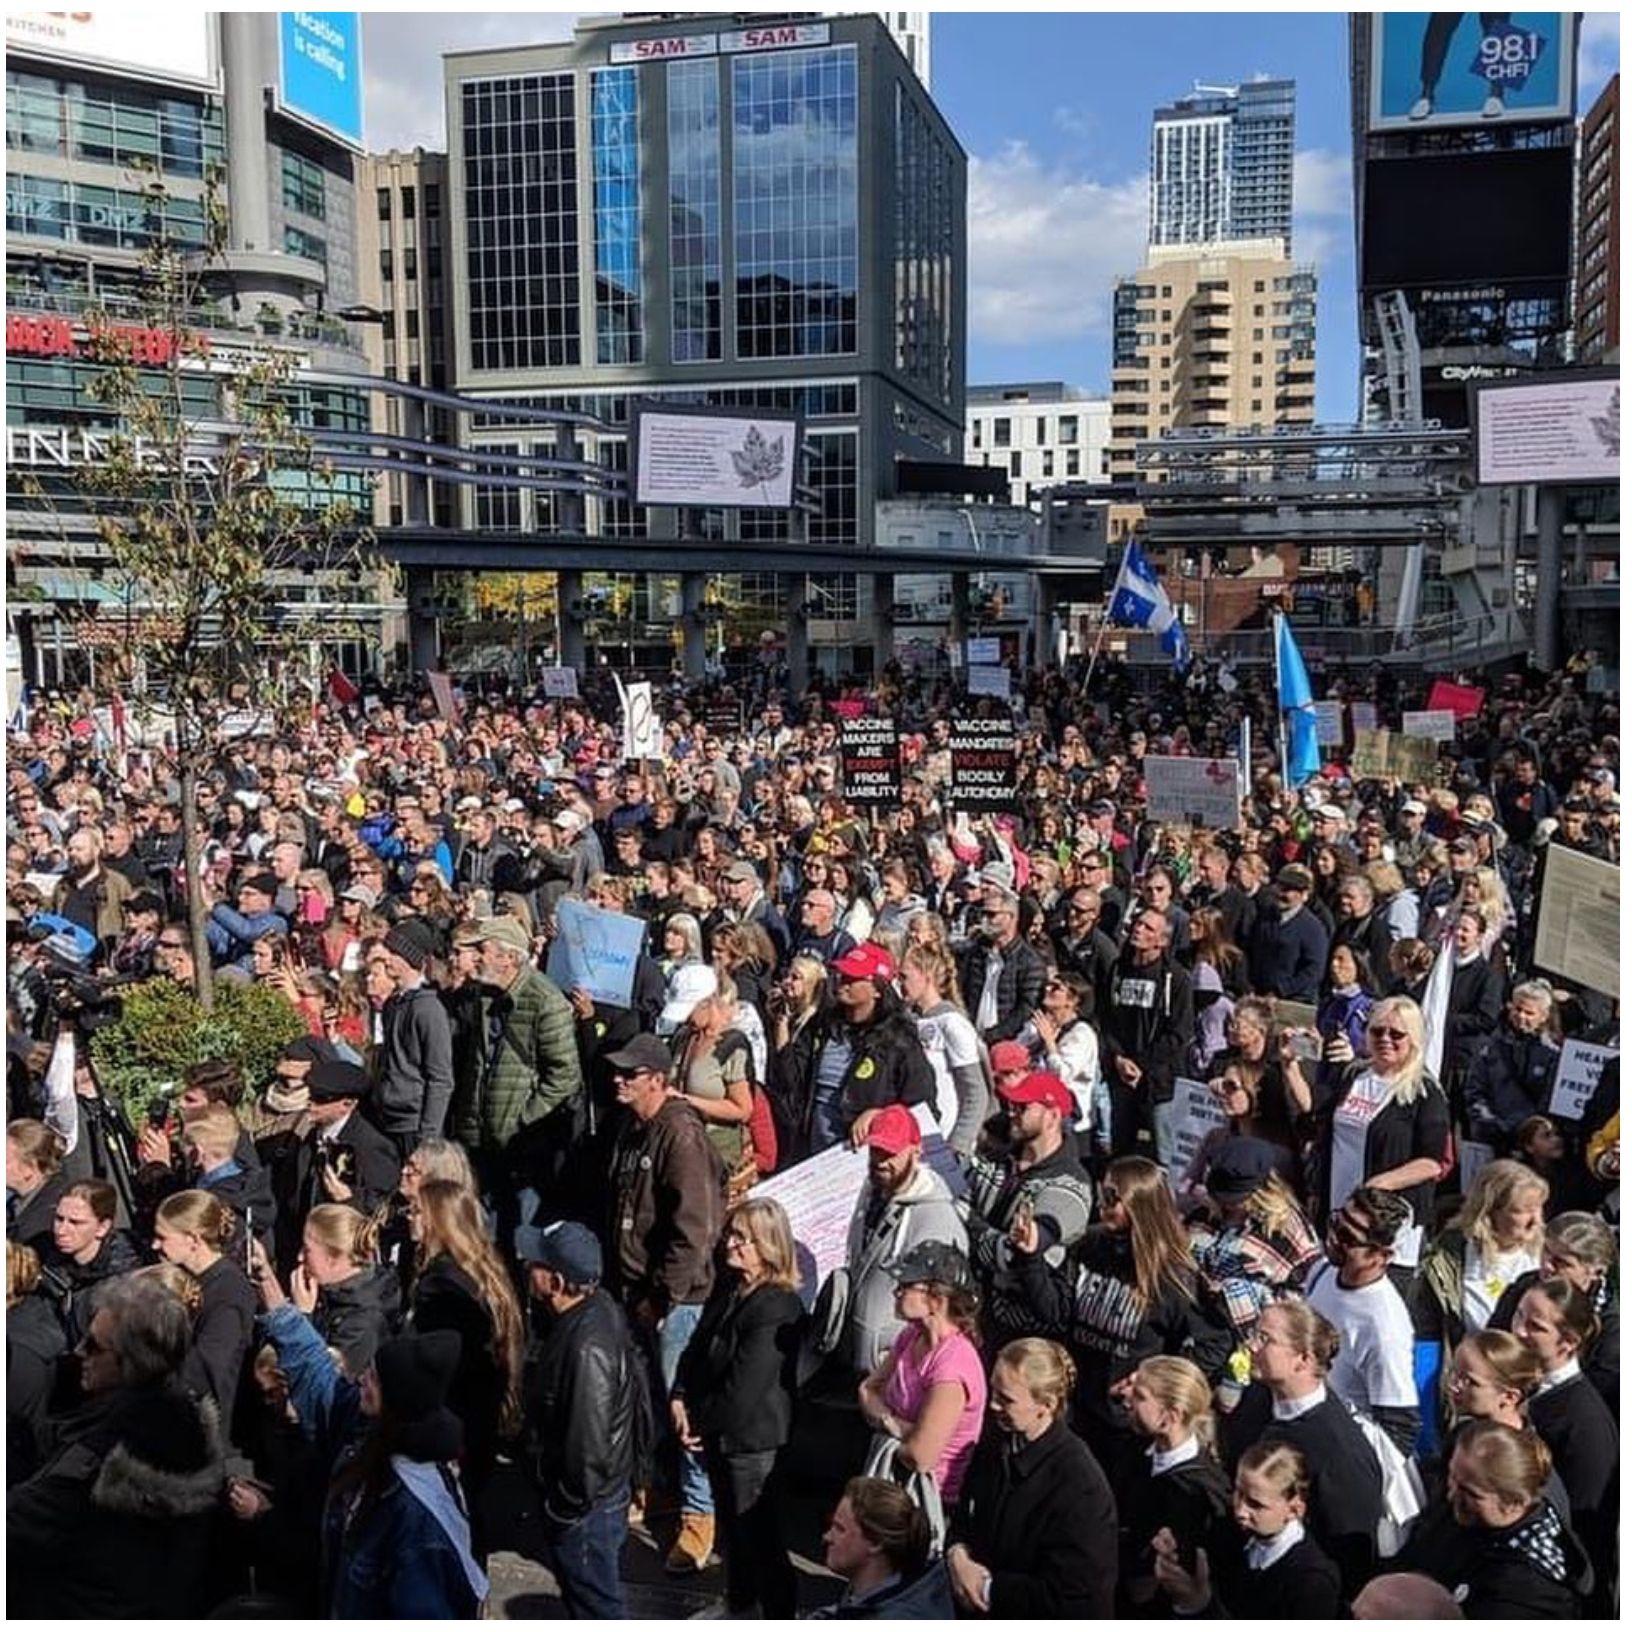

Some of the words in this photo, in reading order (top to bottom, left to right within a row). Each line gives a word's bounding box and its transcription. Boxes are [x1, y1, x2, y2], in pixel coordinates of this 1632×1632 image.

[1480, 33, 1538, 64] 98.1
[1485, 63, 1530, 80] CHFI
[90, 205, 146, 232] DMZ
[1421, 287, 1506, 302] Panasonic
[843, 719, 894, 731] VACCINE
[954, 720, 1013, 732] VACCINE
[842, 733, 896, 745] MAKERS
[949, 738, 1016, 750] MANDATES
[856, 746, 883, 757] ARE
[954, 754, 1010, 766] VIOLATE
[854, 772, 890, 783] FROM
[957, 770, 1006, 783] BODILY
[845, 785, 898, 798] LIABILITY
[951, 786, 1017, 798] AUTONOMY
